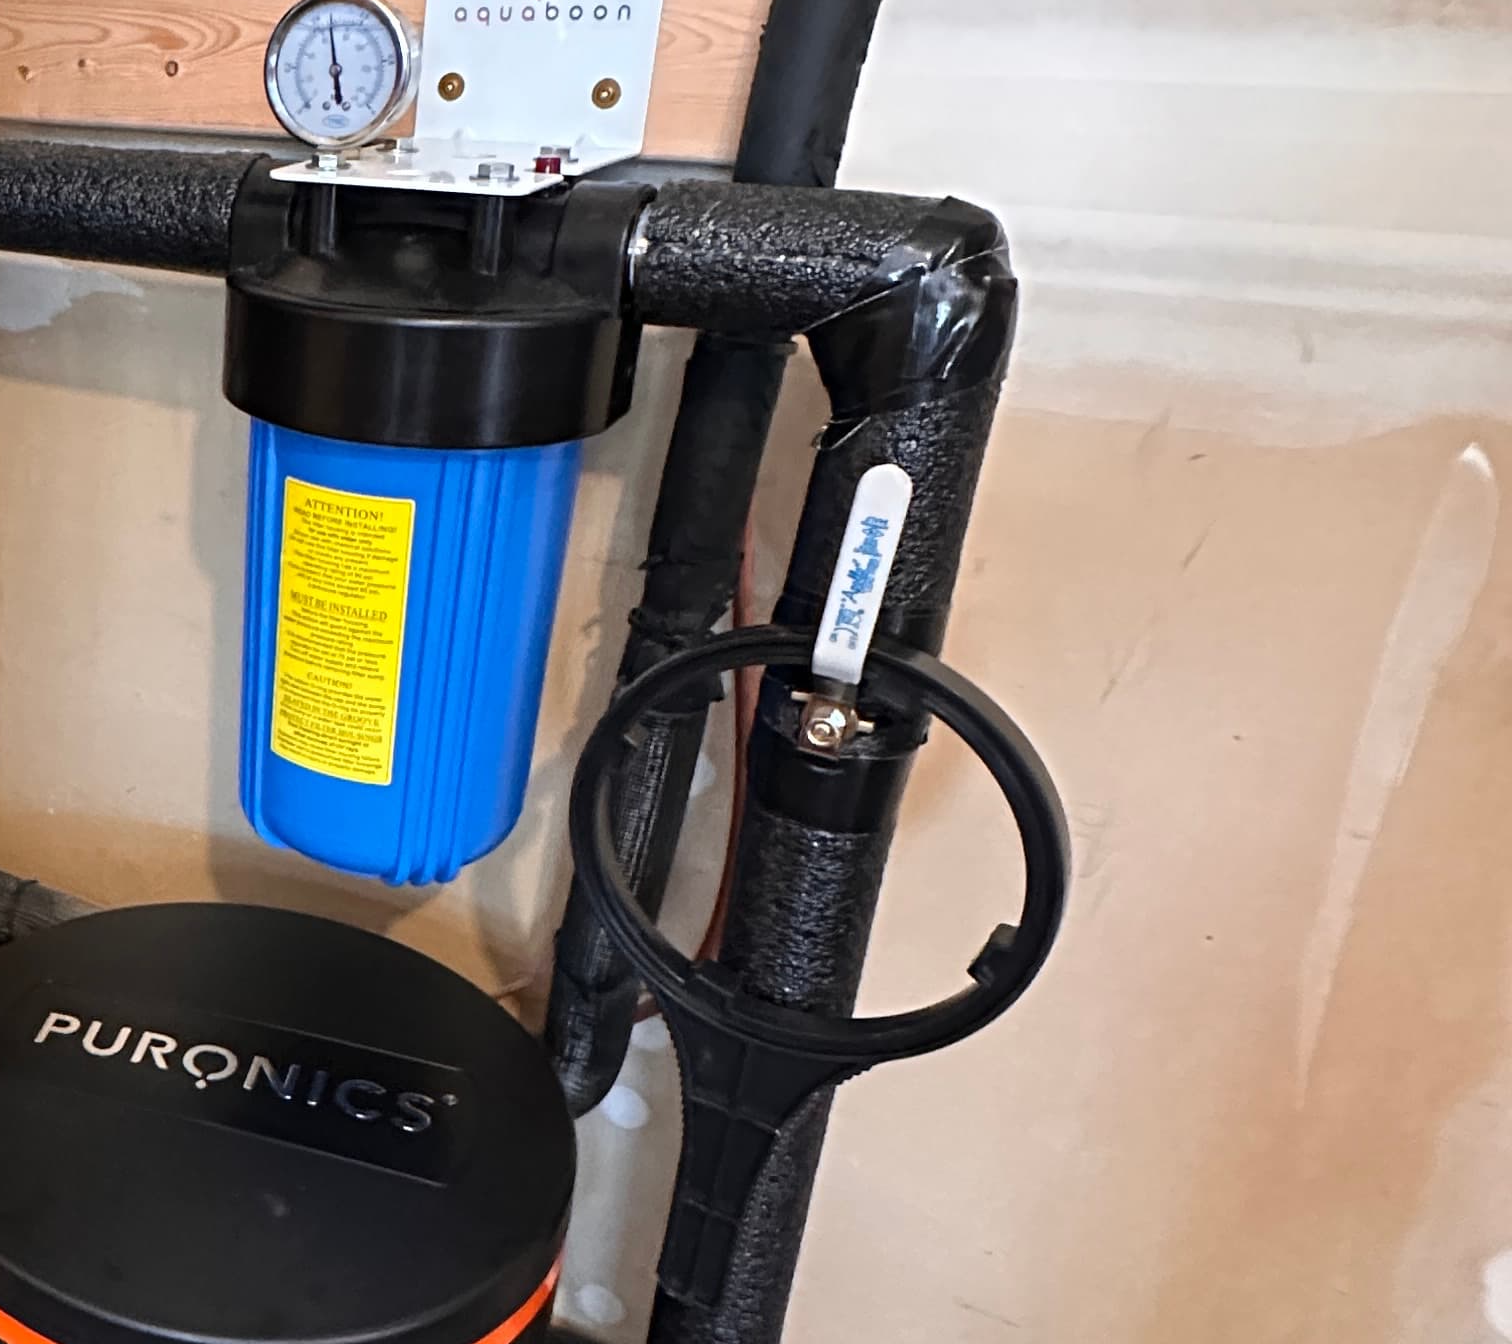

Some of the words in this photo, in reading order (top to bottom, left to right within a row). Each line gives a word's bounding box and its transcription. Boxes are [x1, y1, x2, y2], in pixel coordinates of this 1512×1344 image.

[453, 1, 632, 27] aquaboon
[304, 498, 384, 520] ATTENTION!
[290, 589, 314, 606] MUST
[315, 598, 328, 609] BE
[329, 601, 388, 623] INSTALLED
